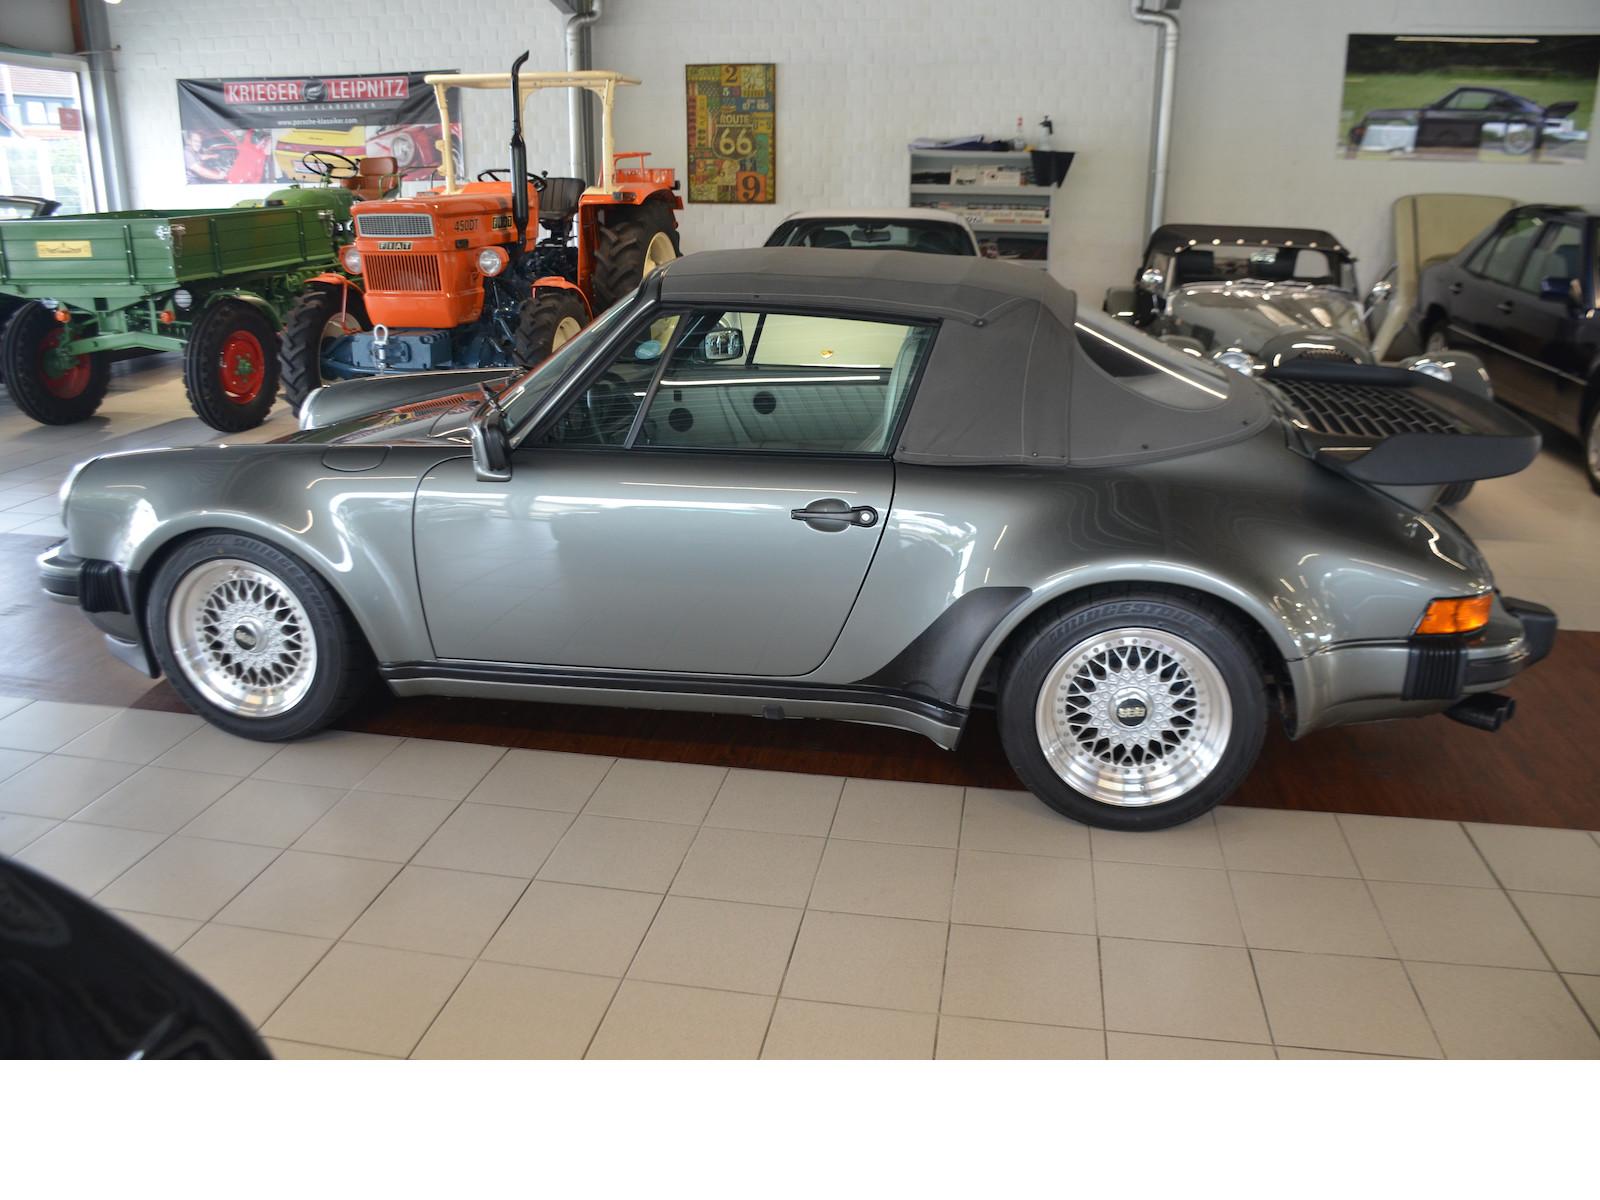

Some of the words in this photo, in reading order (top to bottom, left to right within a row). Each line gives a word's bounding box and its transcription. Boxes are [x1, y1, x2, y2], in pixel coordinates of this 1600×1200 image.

[726, 65, 738, 83] 2
[228, 83, 299, 102] KRIEGER
[332, 79, 405, 99] LEIPNITZ
[257, 104, 306, 112] PORSCHE
[314, 102, 377, 111] KLASSIKER
[277, 117, 358, 127] www.porsche-klassiker.com
[719, 113, 752, 124] ROUTE
[719, 127, 753, 155] 66
[742, 176, 760, 201] 9
[378, 241, 412, 250] FIAT
